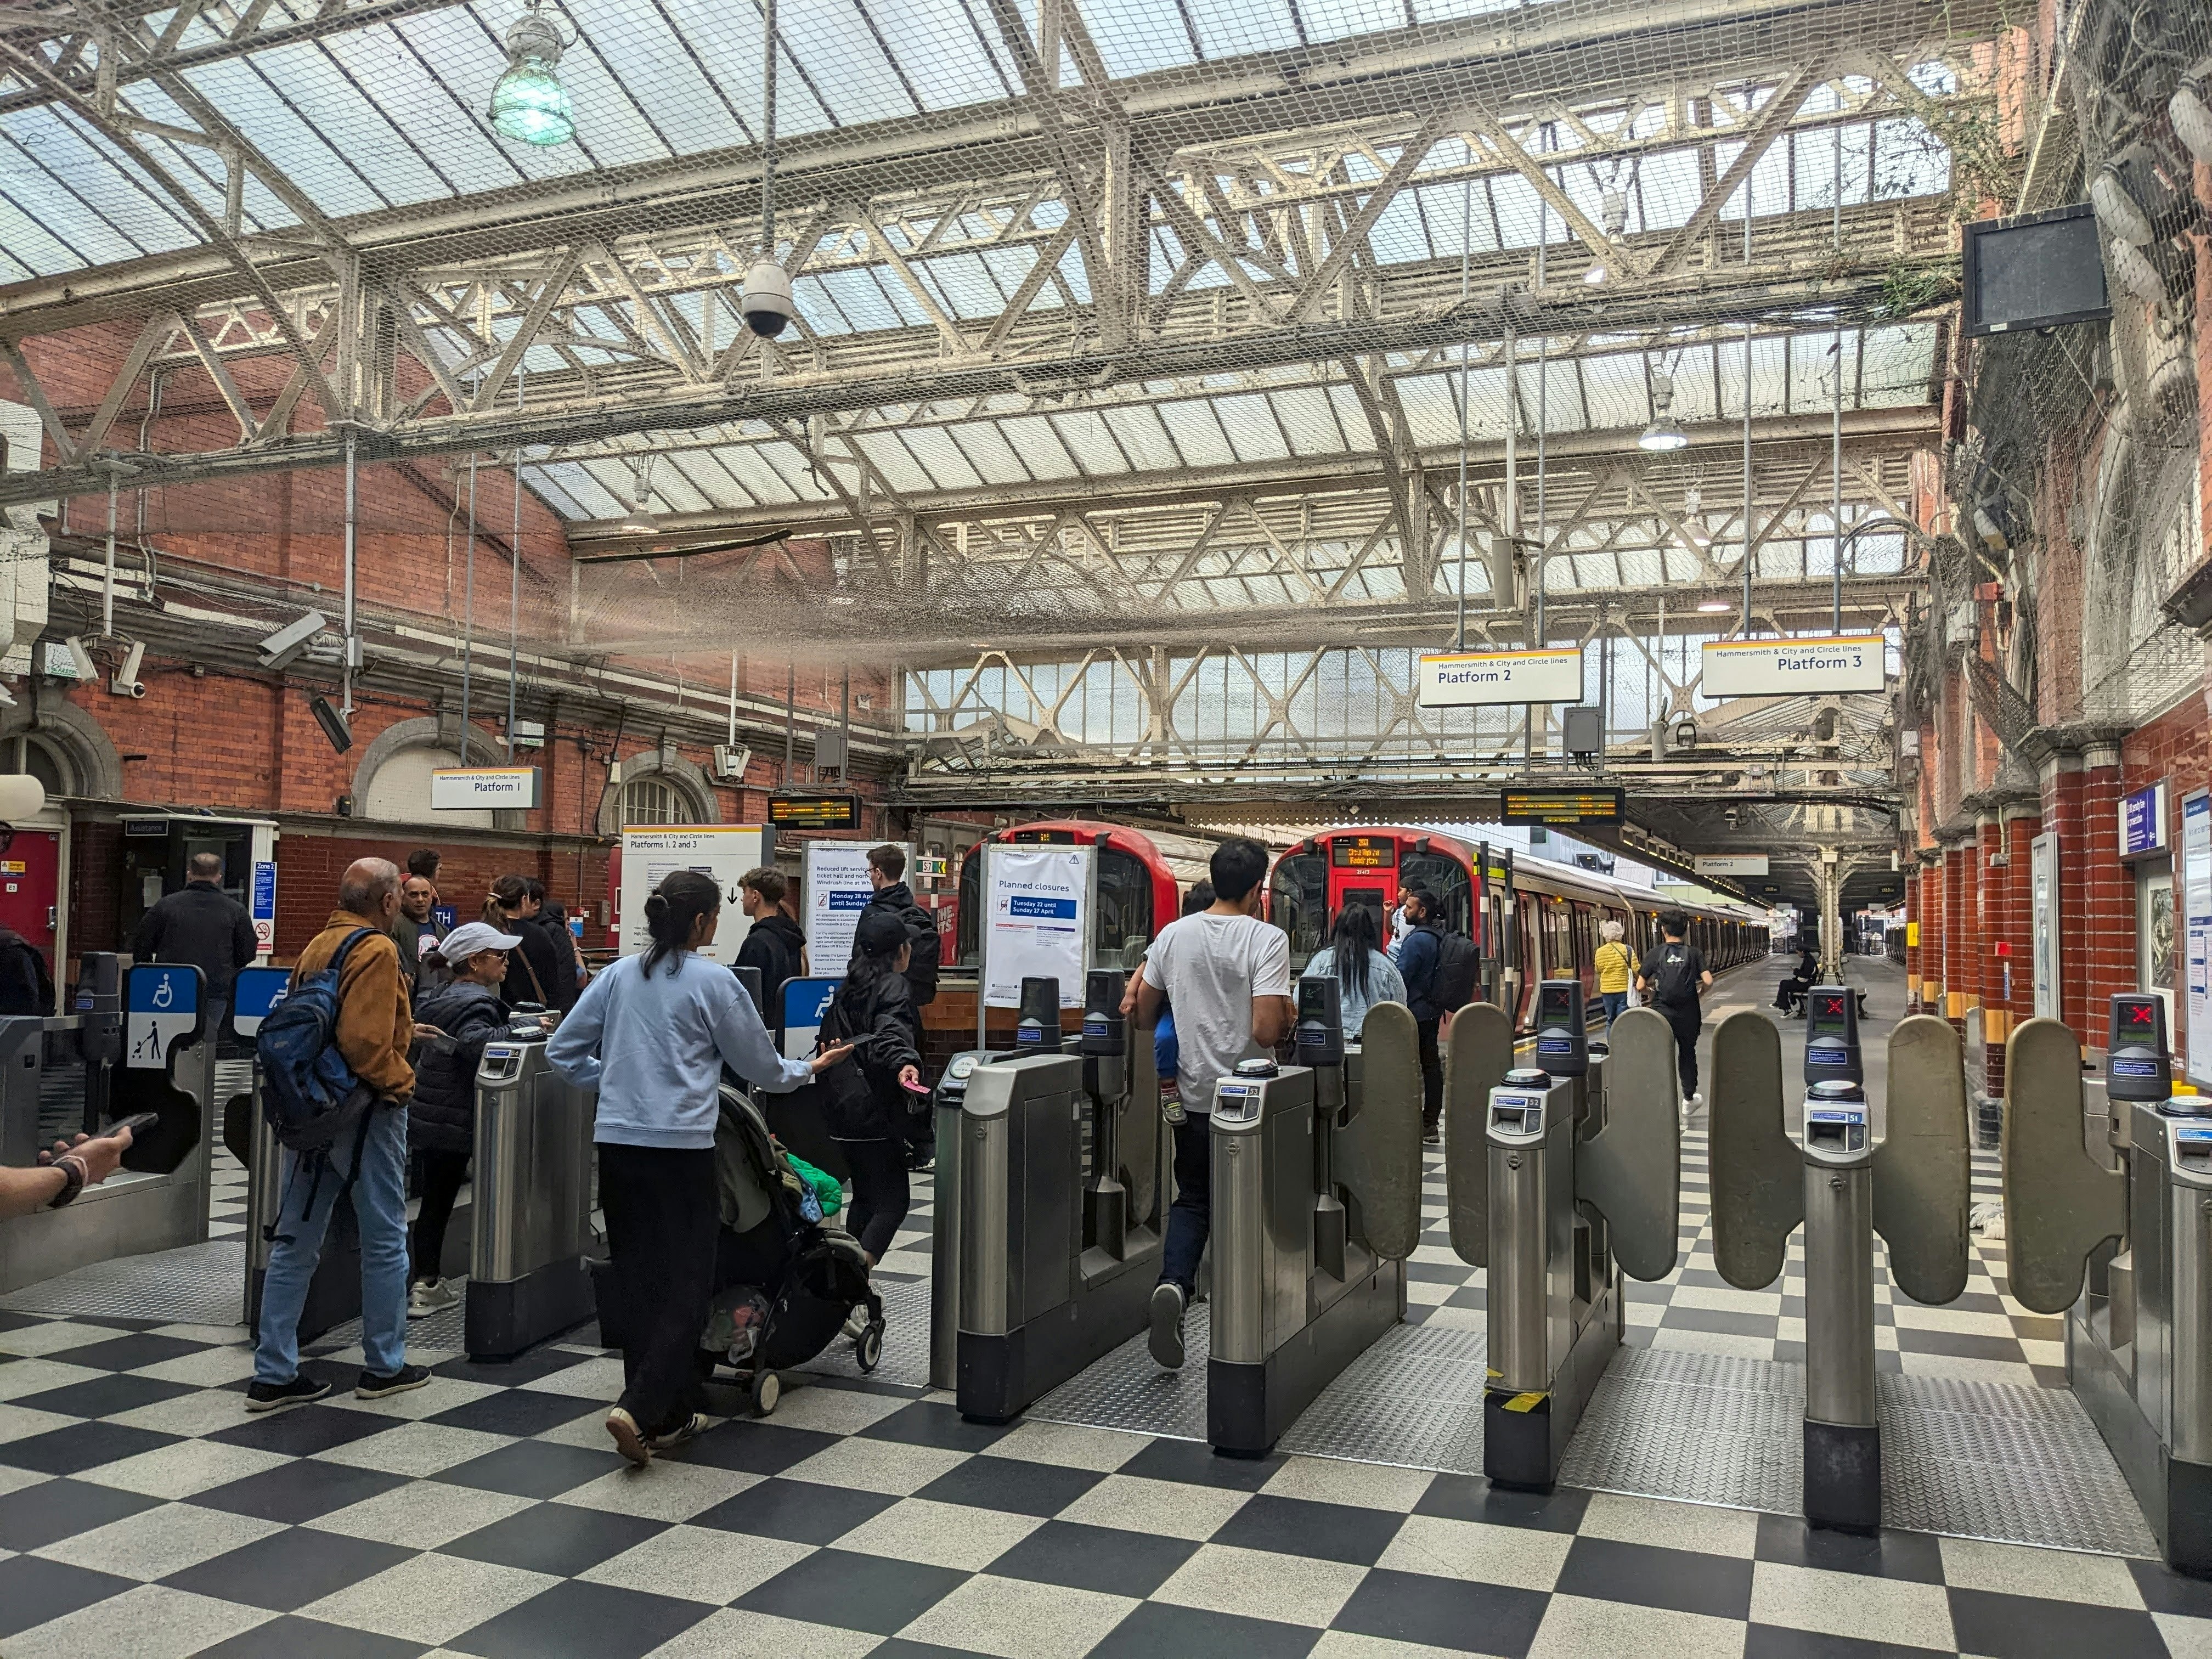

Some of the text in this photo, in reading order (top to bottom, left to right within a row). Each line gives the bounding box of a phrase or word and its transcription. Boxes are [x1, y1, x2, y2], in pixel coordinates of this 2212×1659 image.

[1717, 649, 1771, 657] Hammersmith
[1438, 661, 1487, 669] Hammersmith
[1778, 656, 1862, 670] Platform 3
[1438, 670, 1511, 684] Platform 2
[475, 782, 513, 792] Platform
[1000, 881, 1069, 891] Planned closures
